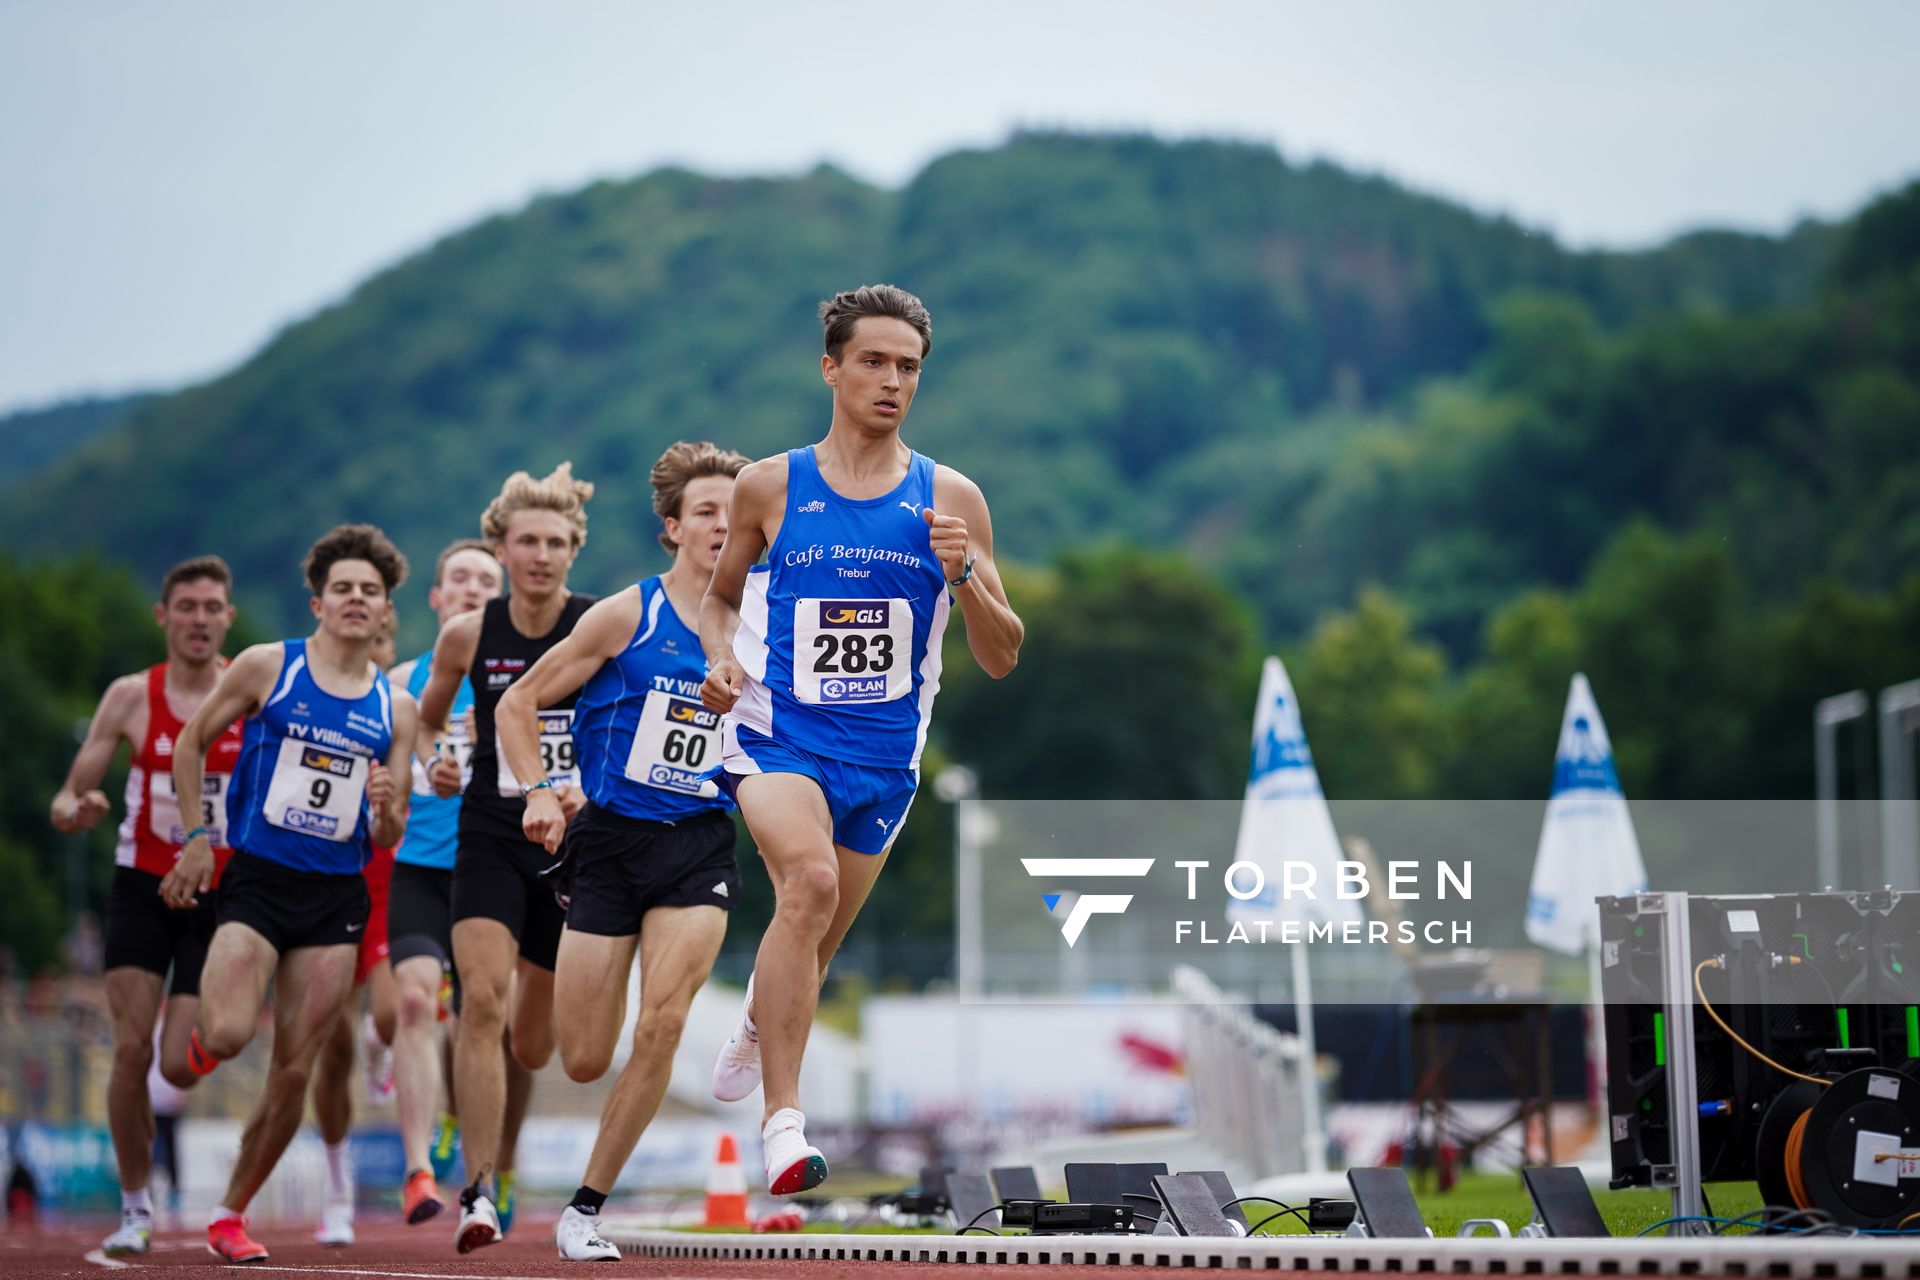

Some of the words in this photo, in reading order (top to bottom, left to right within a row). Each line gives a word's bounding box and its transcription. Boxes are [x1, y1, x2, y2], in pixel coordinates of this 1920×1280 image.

[785, 544, 824, 567] Café
[831, 544, 921, 569] Benjamin
[837, 567, 871, 578] Trebur
[856, 609, 884, 624] GLS
[813, 634, 894, 674] 283
[654, 675, 675, 692] TV
[848, 680, 884, 692] PLAN
[693, 711, 718, 727] GLS
[287, 721, 309, 738] TV
[663, 729, 707, 768] 60
[308, 778, 332, 809] 9
